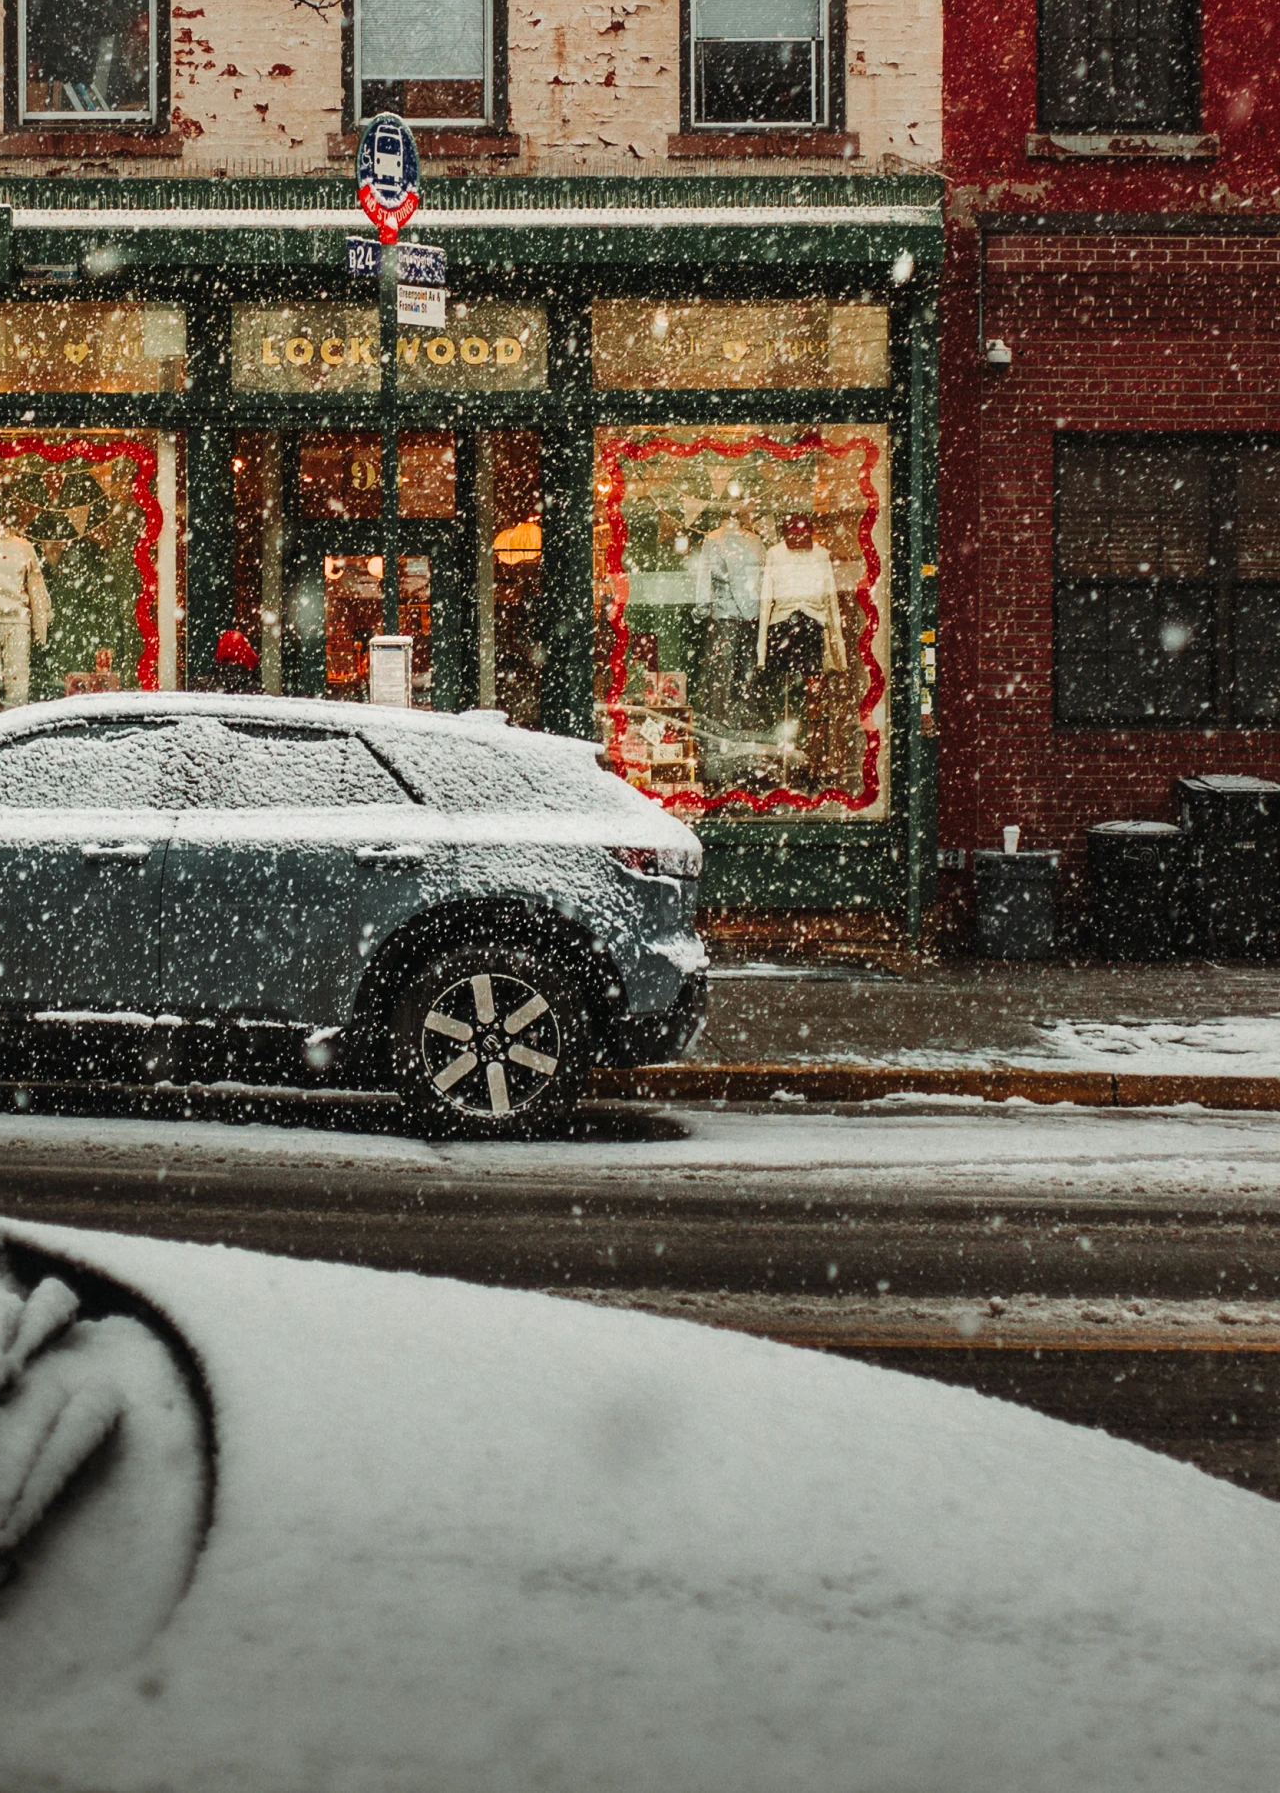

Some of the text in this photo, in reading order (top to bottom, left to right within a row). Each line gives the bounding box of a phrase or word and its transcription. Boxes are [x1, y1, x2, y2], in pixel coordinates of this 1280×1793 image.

[364, 193, 377, 213] NO
[349, 245, 376, 270] B24
[421, 302, 428, 314] St
[262, 336, 523, 365] LOCKWOOD
